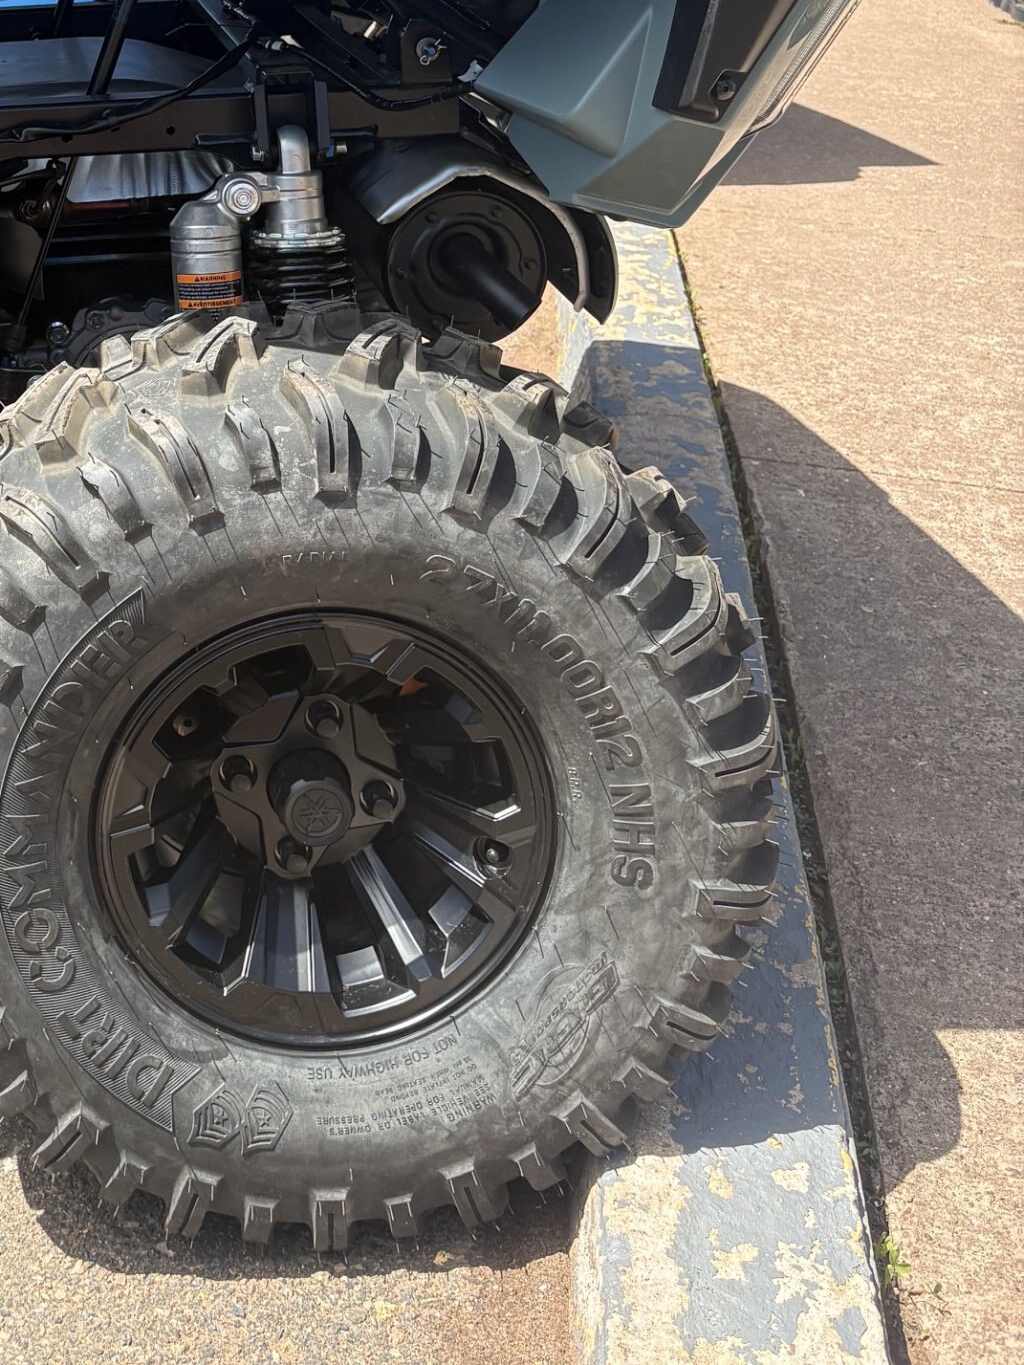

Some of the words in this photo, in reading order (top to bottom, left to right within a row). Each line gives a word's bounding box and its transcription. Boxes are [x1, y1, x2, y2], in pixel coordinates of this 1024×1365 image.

[200, 274, 227, 282] WARNING
[193, 299, 236, 308] AVERTISSEMENT
[4, 619, 149, 992] COMMANDER
[608, 783, 656, 891] NHS
[56, 995, 175, 1108] DIRT
[433, 1034, 457, 1055] NOT
[404, 1046, 430, 1066] FOR
[307, 1067, 333, 1081] USE
[338, 1055, 400, 1080] HIGHWAY
[473, 1082, 491, 1098] SEE
[426, 1093, 446, 1107] FOR
[430, 1095, 470, 1116] VEHICLE
[316, 1115, 366, 1126] PRESSURE
[370, 1101, 424, 1122] OPERATING
[396, 1111, 426, 1126] LABEL
[378, 1120, 392, 1131] OR
